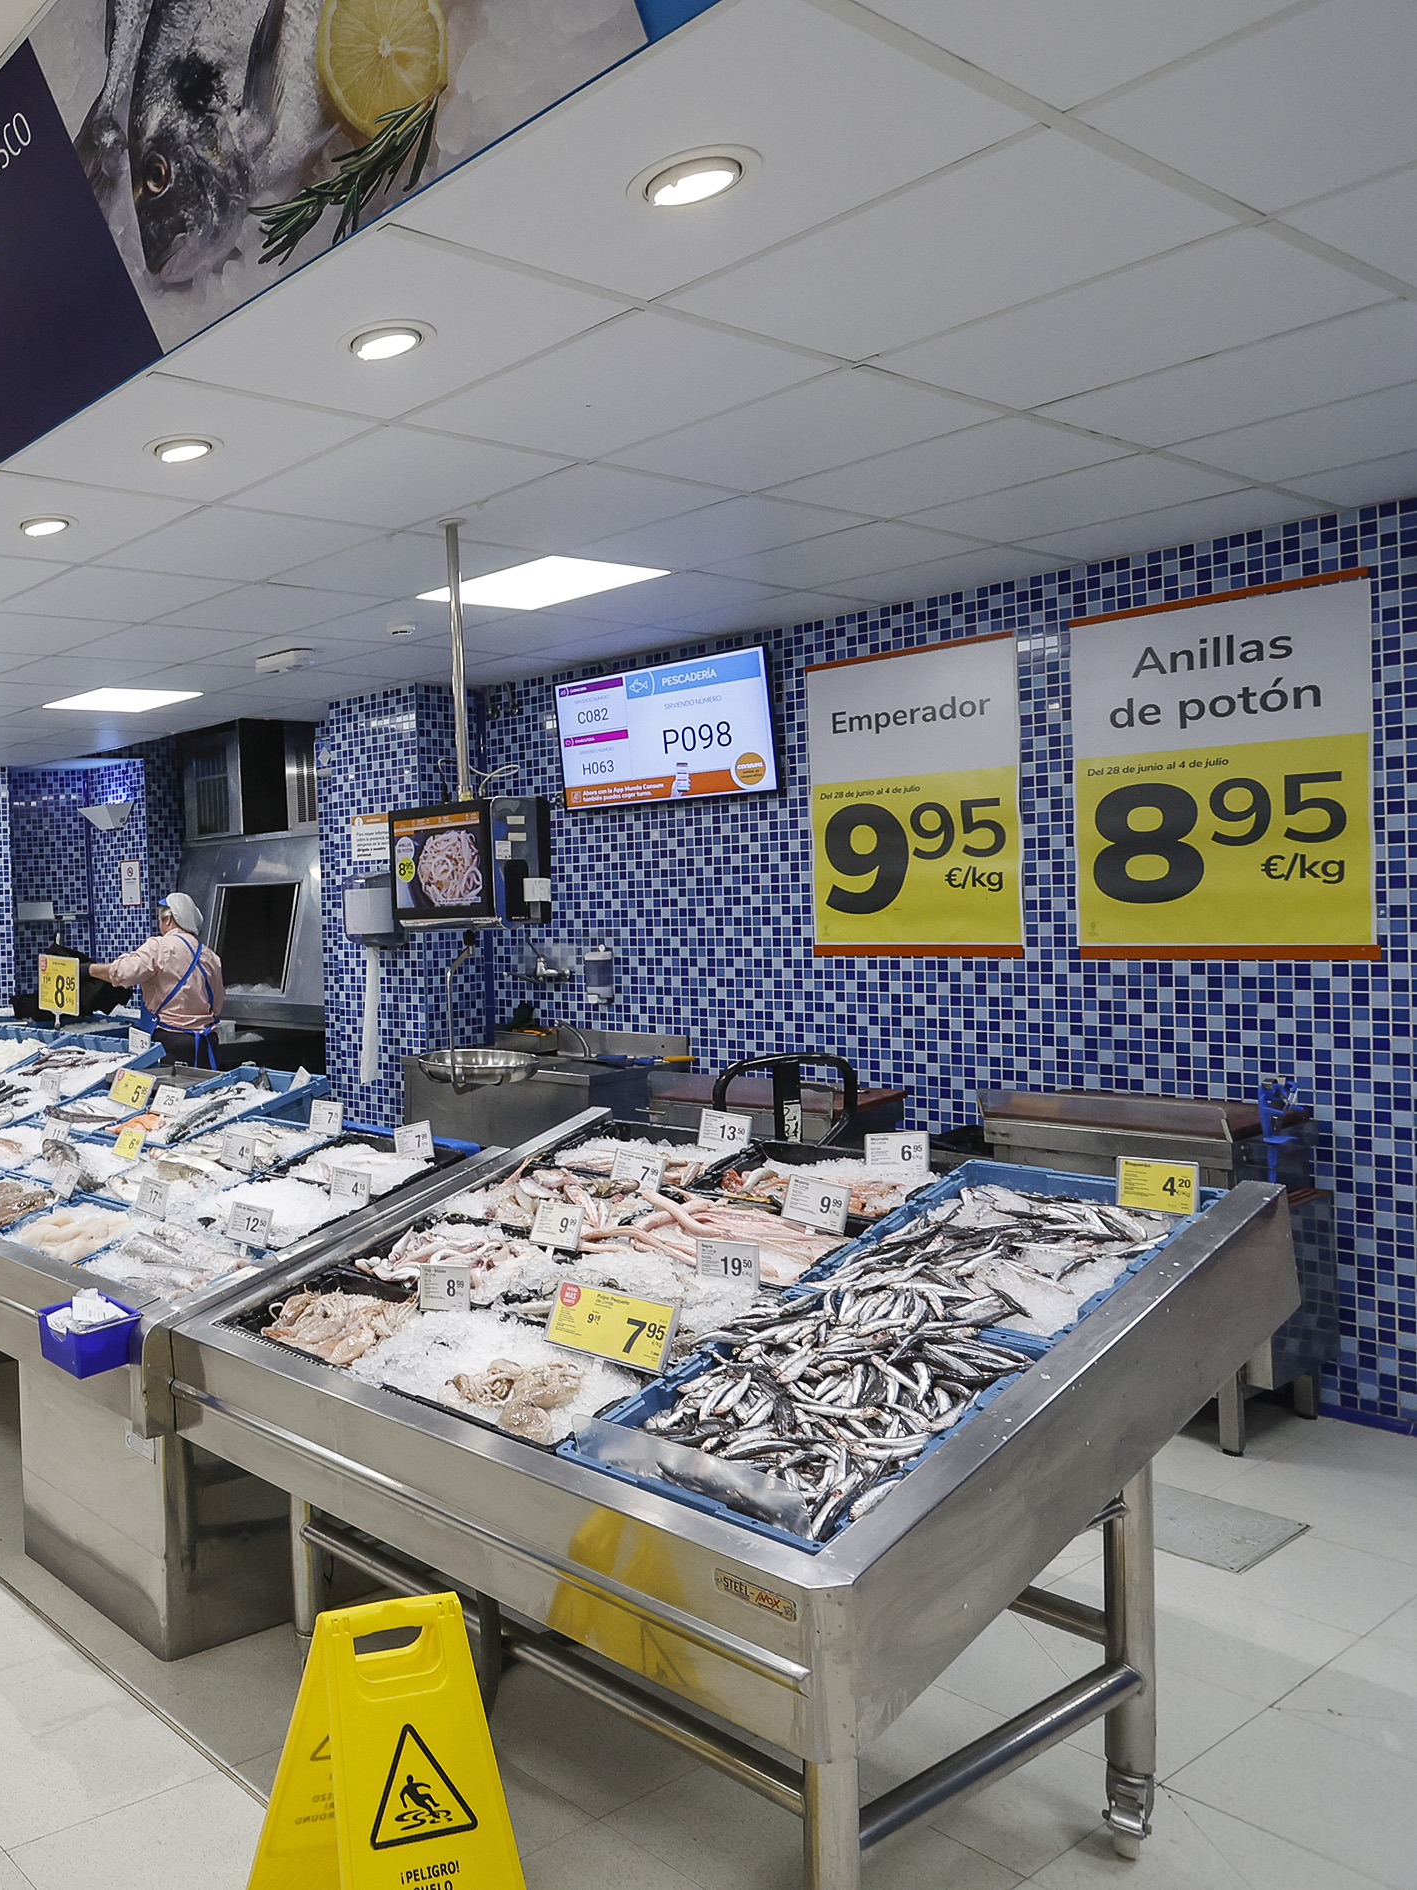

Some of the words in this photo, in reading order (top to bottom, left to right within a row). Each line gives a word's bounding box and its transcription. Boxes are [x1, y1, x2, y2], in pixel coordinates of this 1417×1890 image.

[1132, 633, 1293, 679] Anillas
[661, 668, 717, 687] PESCADERÍA
[578, 708, 609, 724] C082
[664, 699, 694, 710] SIRVIENDO
[831, 696, 990, 735] Emperador
[1109, 698, 1160, 729] de
[1180, 678, 1322, 729] potón
[662, 721, 732, 754] P098
[582, 760, 614, 775] H063
[1087, 768, 1104, 776] Del
[1107, 766, 1120, 775] 28
[1122, 765, 1135, 773] de
[1136, 763, 1163, 774] junio
[1166, 762, 1175, 770] al
[1189, 760, 1202, 768] de
[1204, 757, 1229, 769] julio
[855, 790, 874, 798] junio
[903, 785, 920, 794] julio
[944, 865, 1004, 892] €/kg
[1261, 853, 1345, 885] €/kg
[400, 1860, 460, 1885] ¡PELIGRO!
